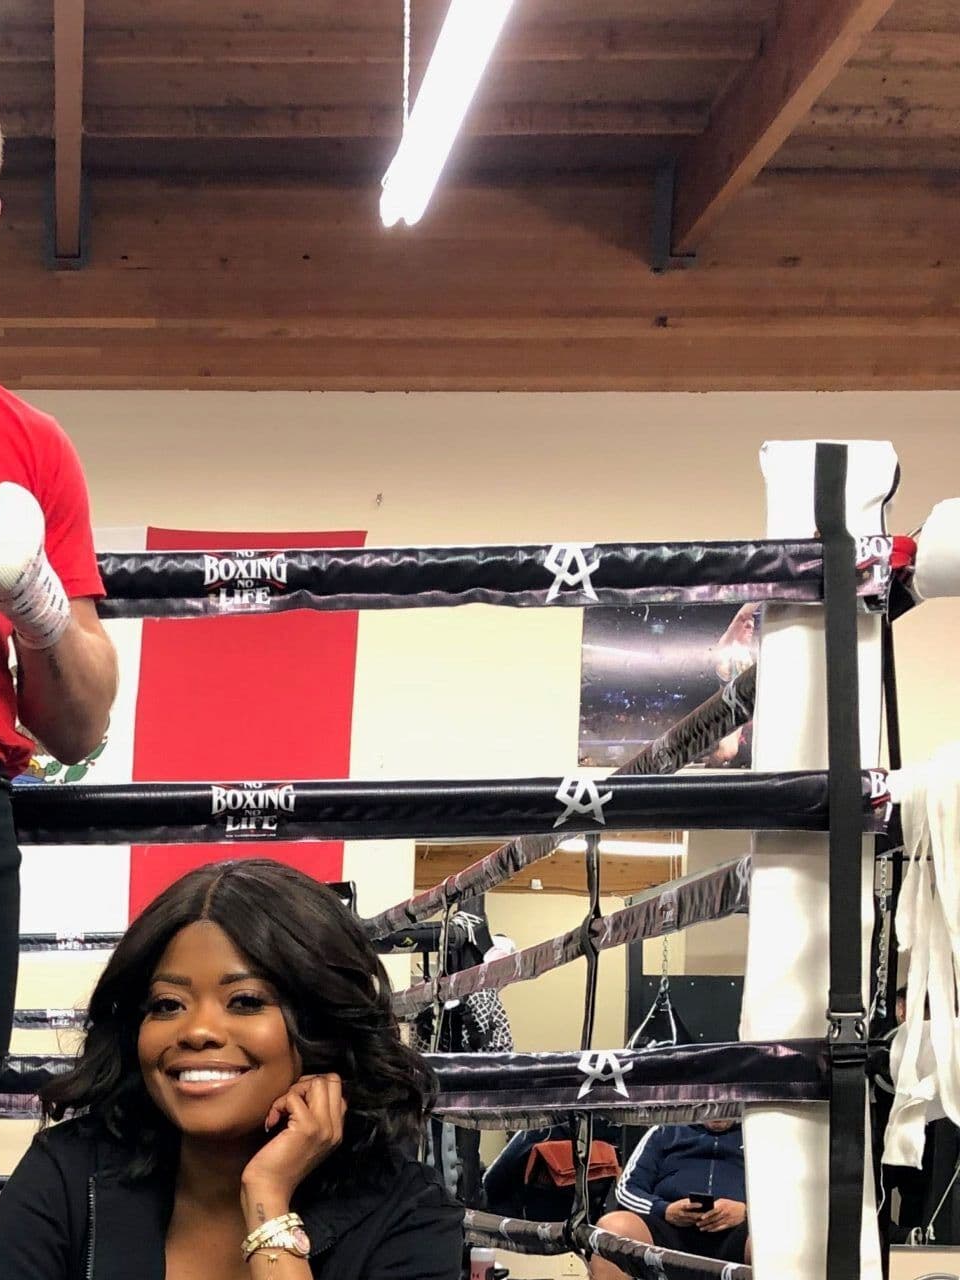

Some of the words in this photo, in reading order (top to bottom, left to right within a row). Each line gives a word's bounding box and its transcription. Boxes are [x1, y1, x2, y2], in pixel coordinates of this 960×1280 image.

[203, 553, 288, 585] BOXING
[237, 580, 254, 588] NO
[220, 587, 271, 605] LIFE
[211, 784, 296, 815] BOXING
[226, 815, 277, 832] LIFE
